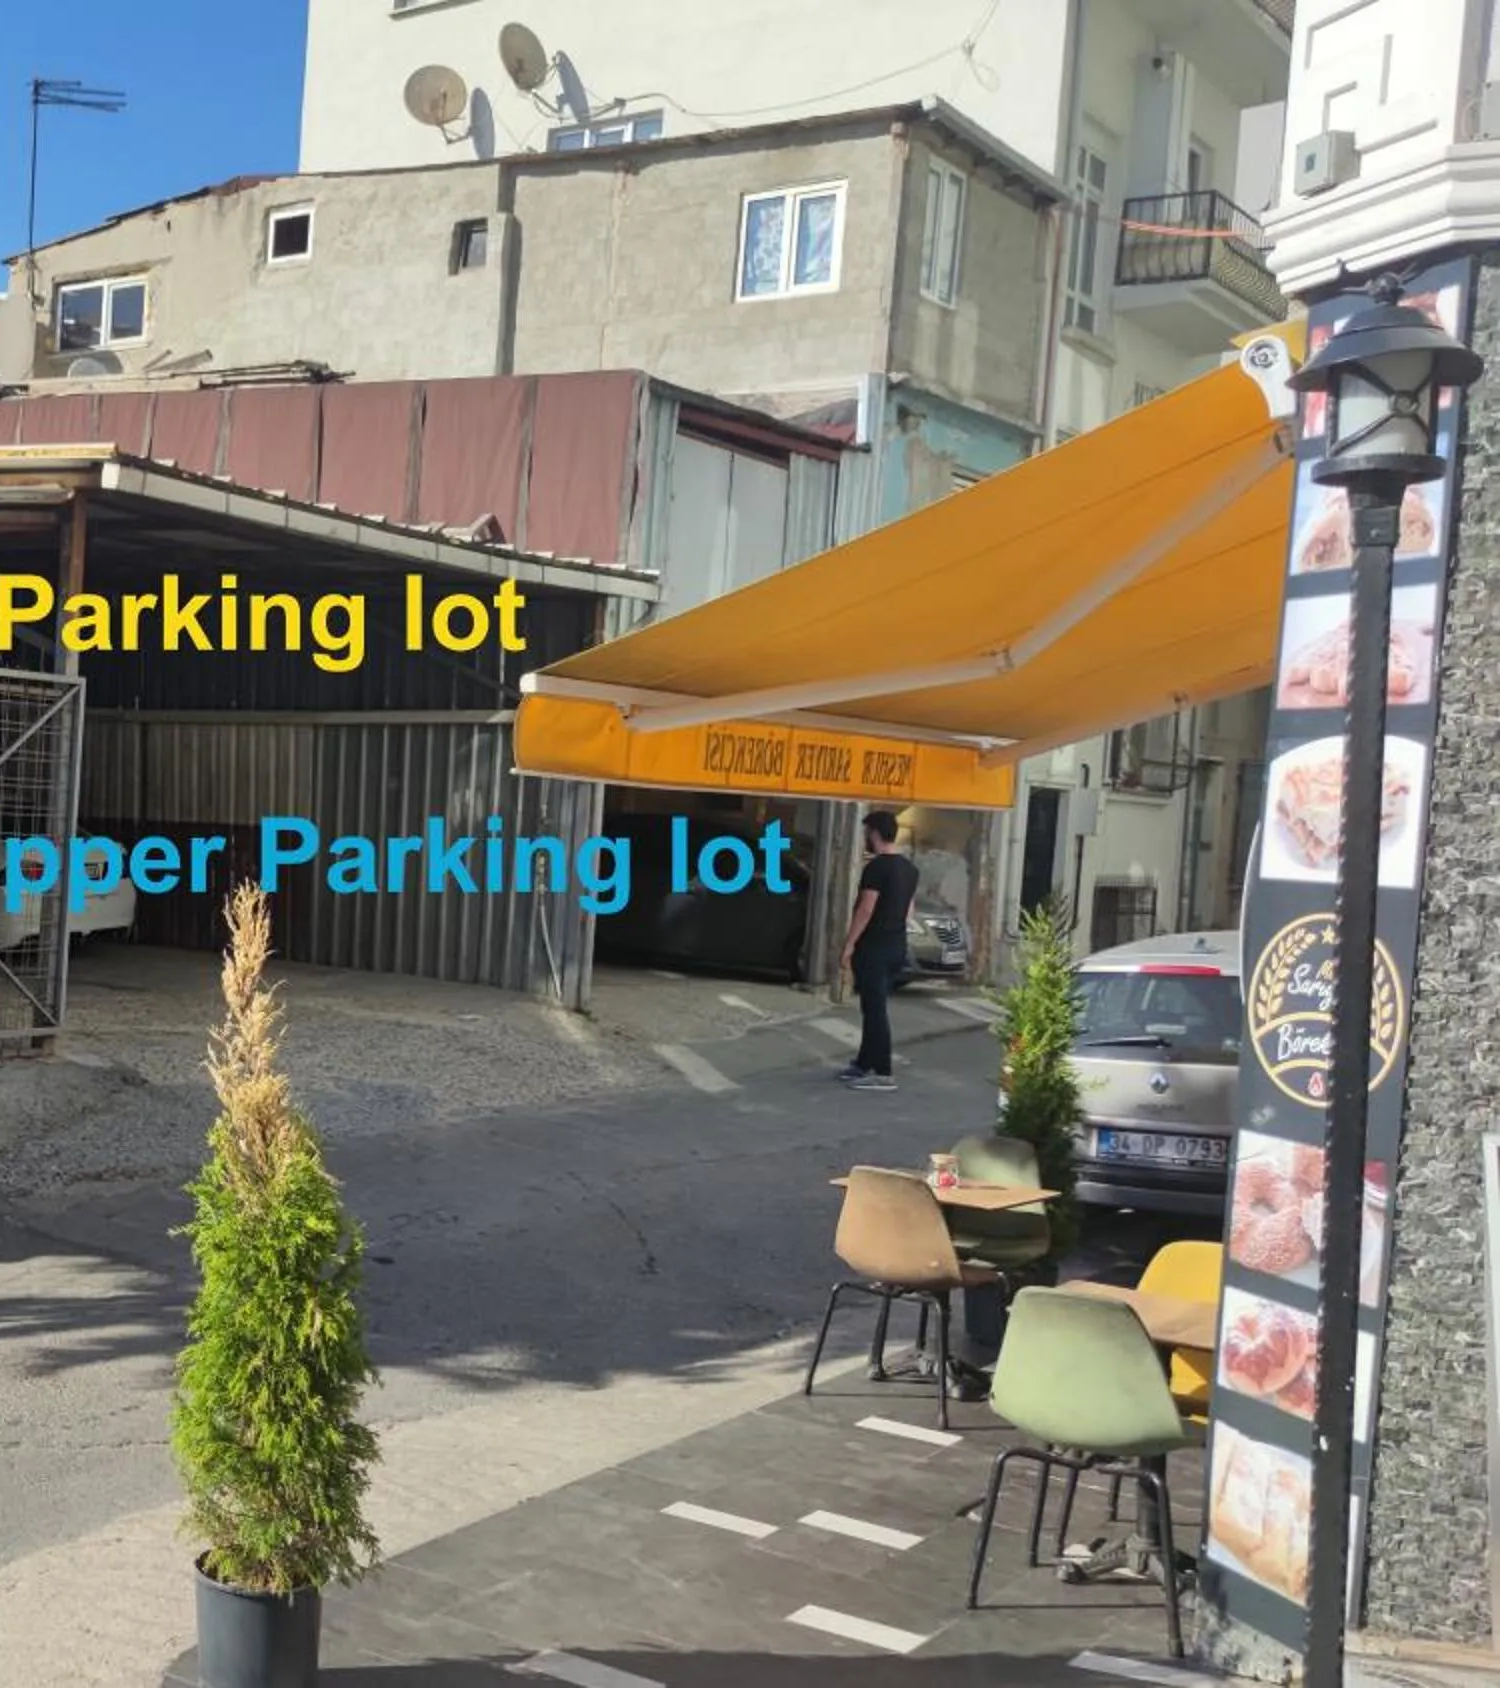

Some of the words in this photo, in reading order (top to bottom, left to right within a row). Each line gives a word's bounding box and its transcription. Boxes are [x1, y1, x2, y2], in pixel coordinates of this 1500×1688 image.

[1110, 1134, 1131, 1151] 34
[1142, 1135, 1165, 1156] DP
[1176, 1137, 1224, 1159] 0793
